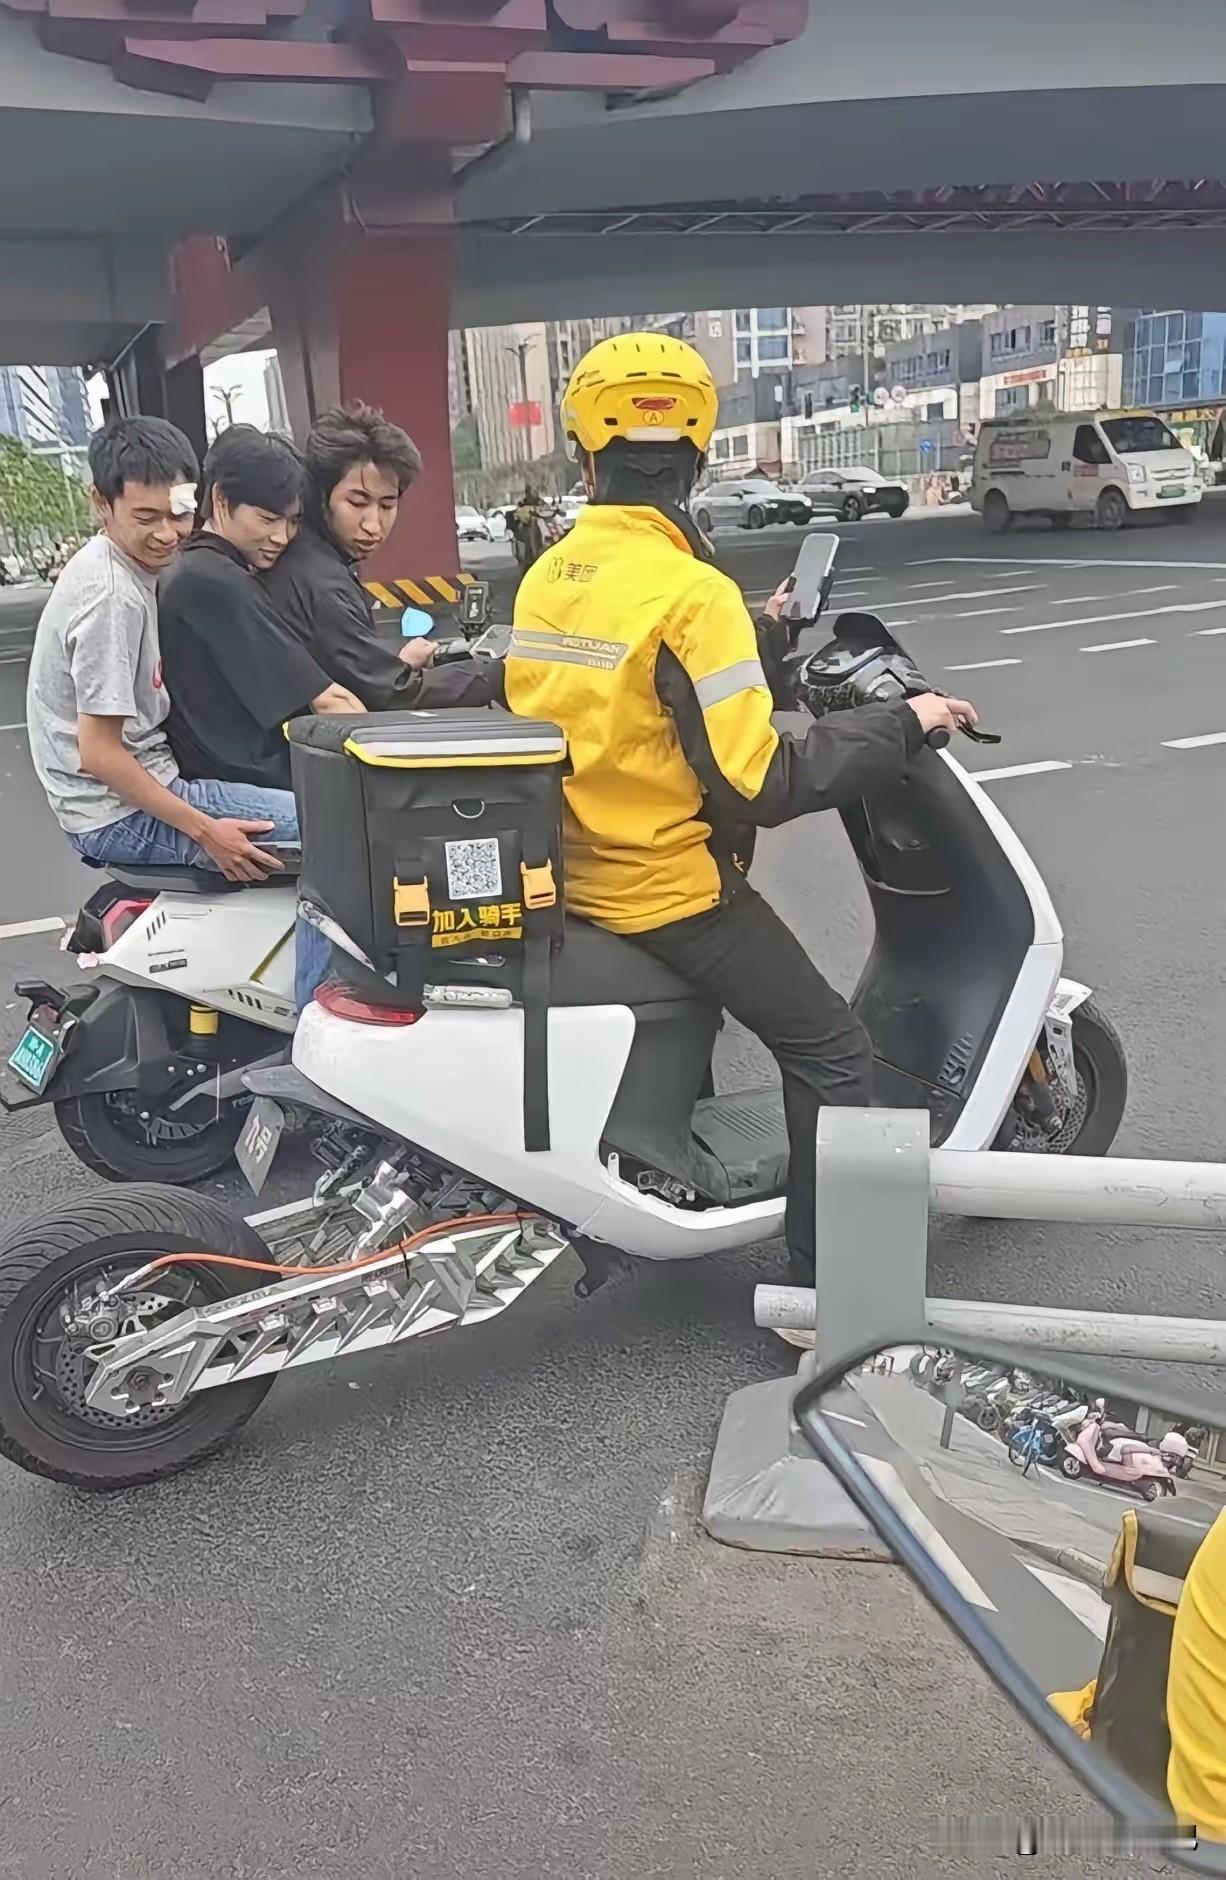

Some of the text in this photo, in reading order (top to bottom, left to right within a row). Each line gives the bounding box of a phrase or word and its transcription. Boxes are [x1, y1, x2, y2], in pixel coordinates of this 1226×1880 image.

[564, 562, 598, 582] 美团
[432, 903, 522, 933] 加入骑手
